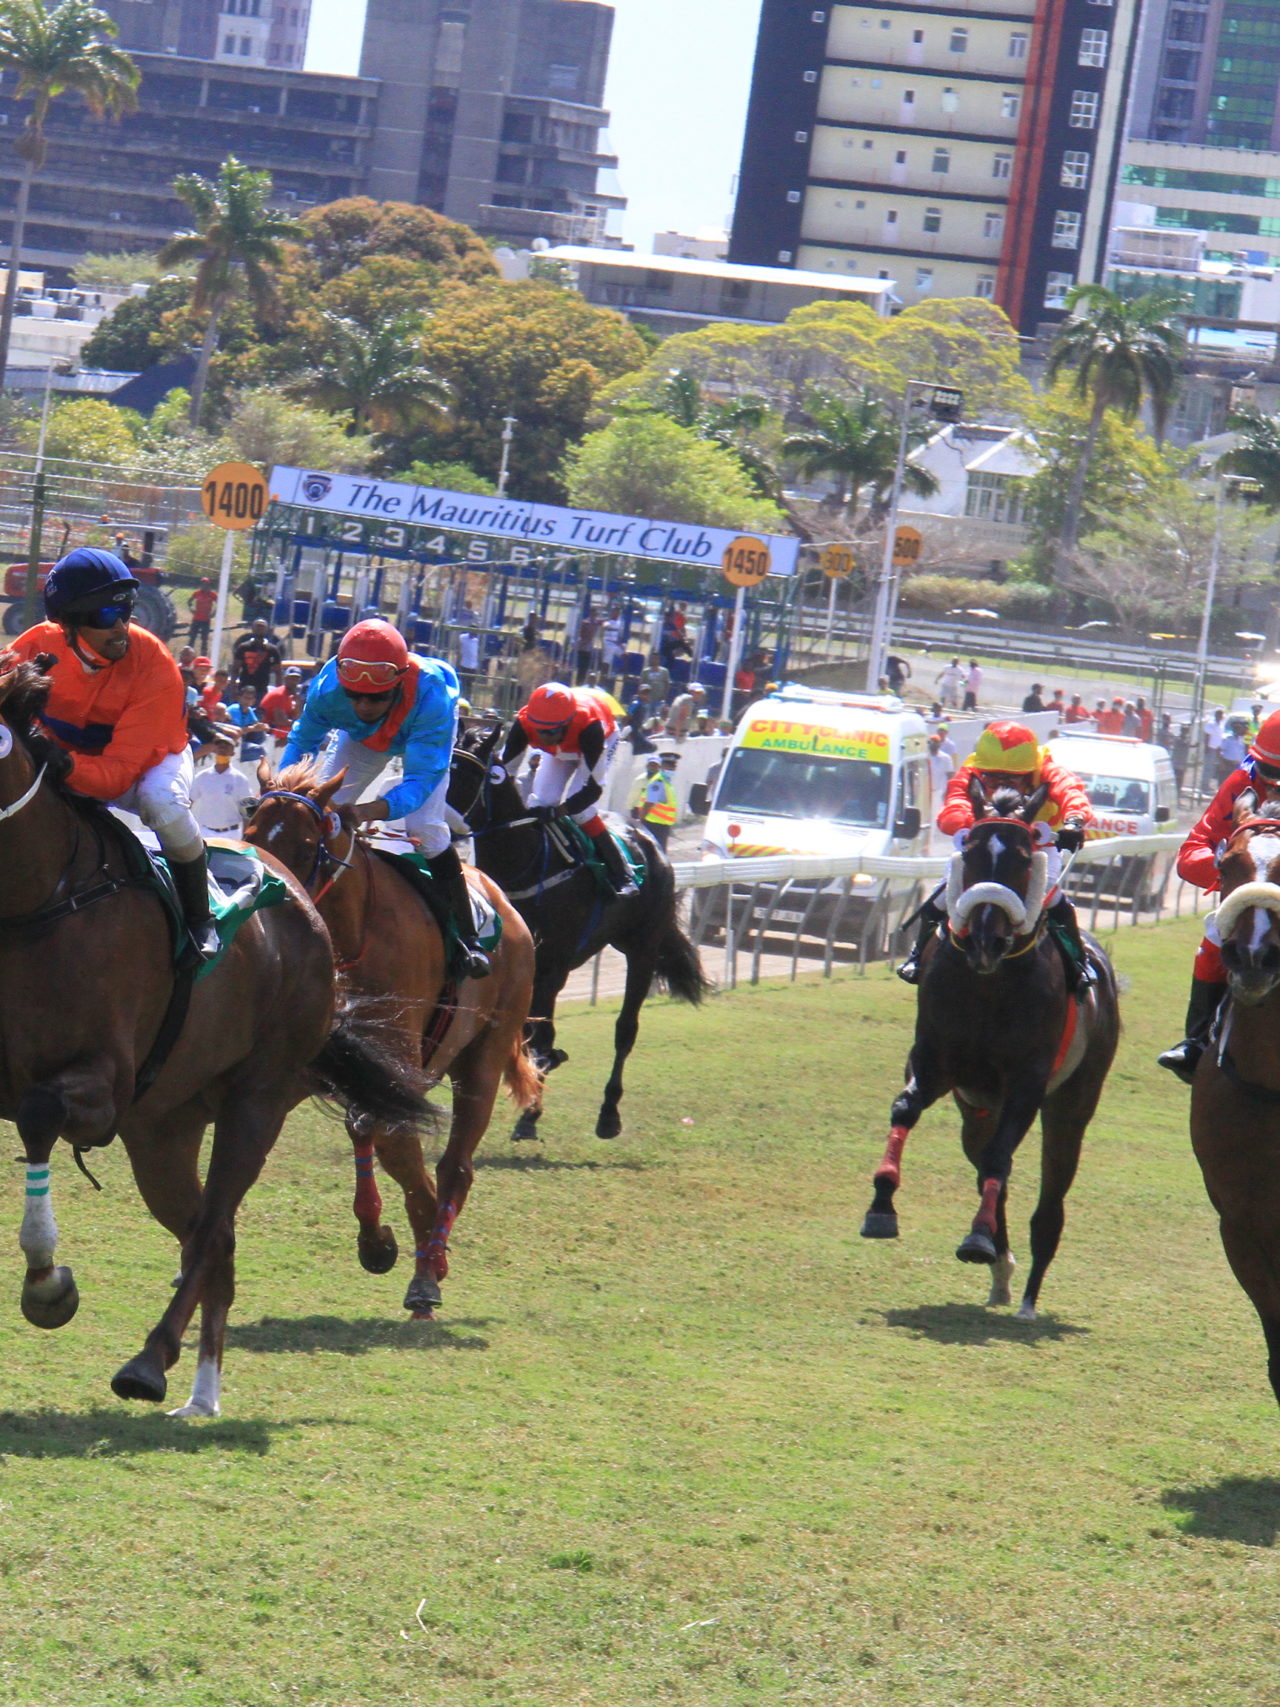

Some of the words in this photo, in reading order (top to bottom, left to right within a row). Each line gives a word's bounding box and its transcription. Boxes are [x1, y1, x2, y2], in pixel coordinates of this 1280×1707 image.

[205, 481, 264, 520] 1400
[346, 483, 401, 514] The
[408, 493, 558, 537] Mauritius
[569, 515, 637, 546] Turf
[639, 526, 713, 558] Club
[305, 516, 315, 535] 1
[341, 522, 364, 543] 2
[383, 527, 405, 548] 3
[426, 535, 446, 554] 4
[468, 540, 489, 561] 5
[510, 546, 531, 566] 6
[724, 548, 769, 577] 1450
[761, 738, 869, 759] AMBULANCE
